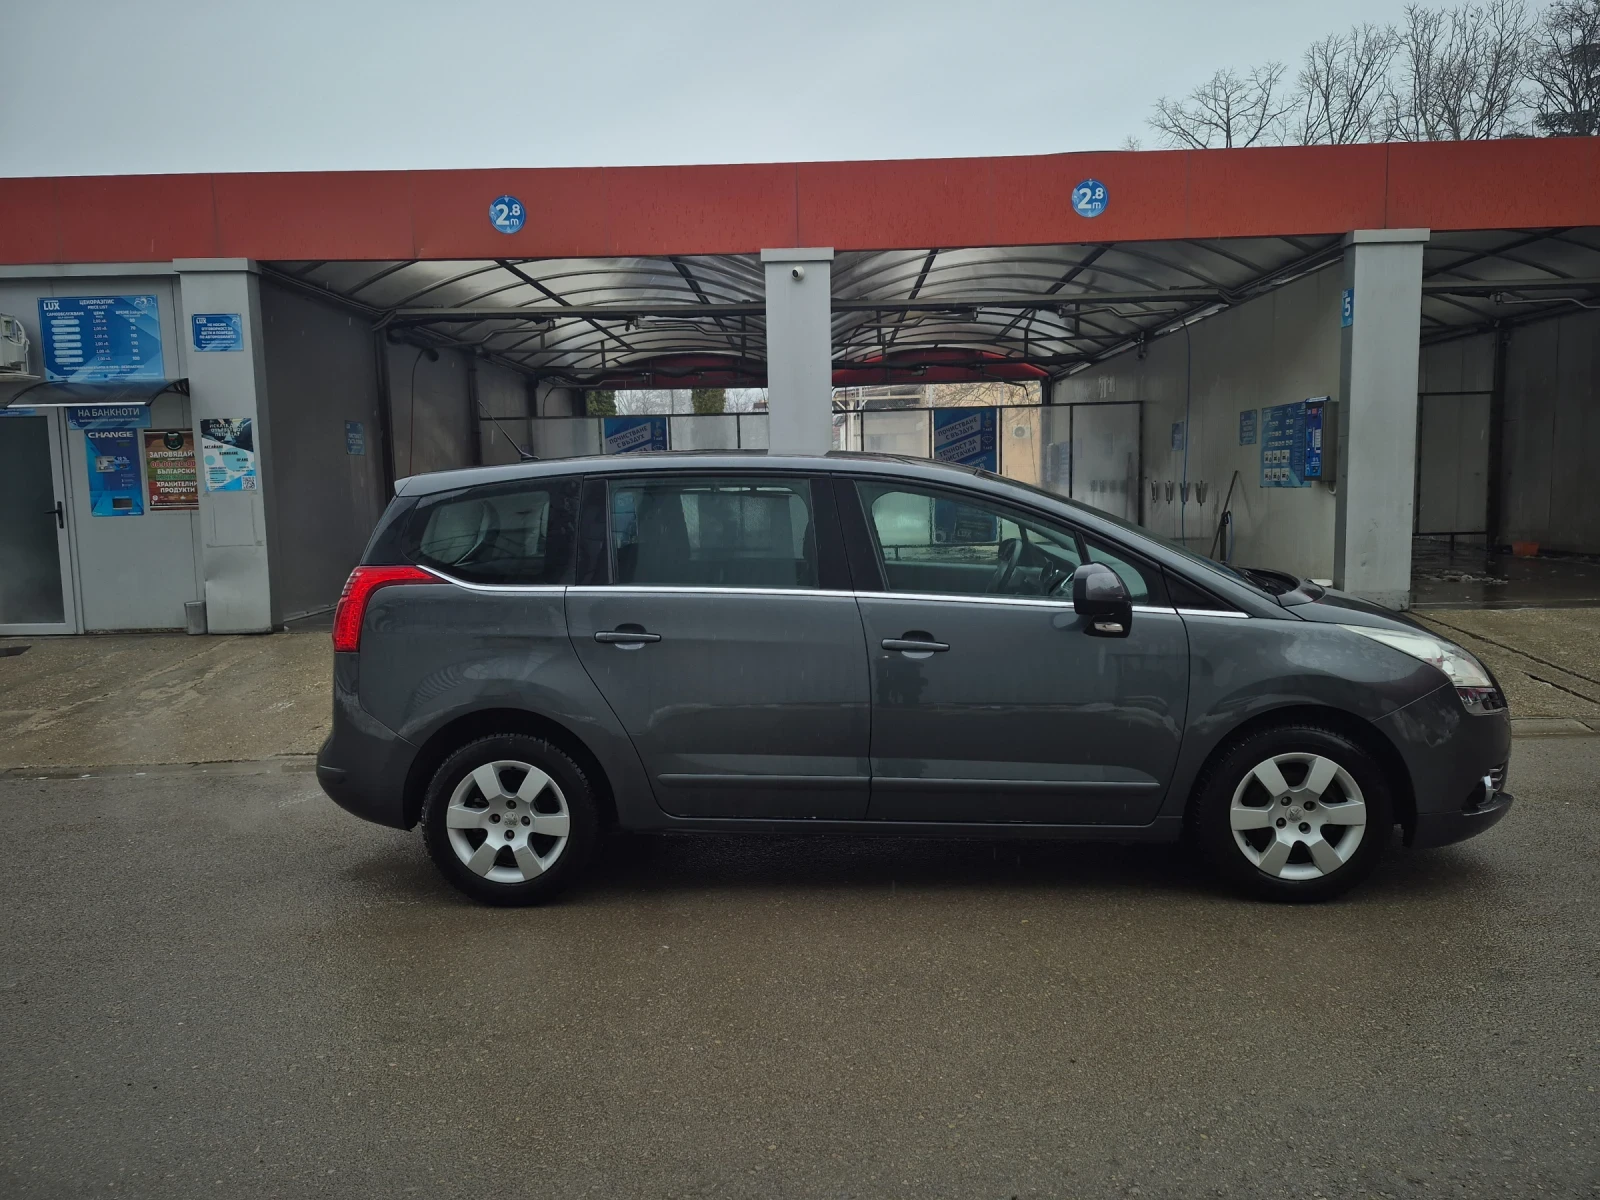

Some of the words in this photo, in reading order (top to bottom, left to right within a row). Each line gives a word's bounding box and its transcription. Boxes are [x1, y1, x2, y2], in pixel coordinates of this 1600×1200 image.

[43, 302, 60, 310] LUX
[1344, 296, 1351, 316] 5
[92, 408, 140, 416] БАНКНОТИ
[938, 416, 978, 436] ПОЧИСТВАНЕ
[950, 425, 974, 439] ВЪЗДУХ
[609, 426, 648, 444] ПОЧИСТВАНЕ
[621, 434, 644, 446] ВЪЗДУХ
[939, 442, 967, 457] ТЕЧНОСТ
